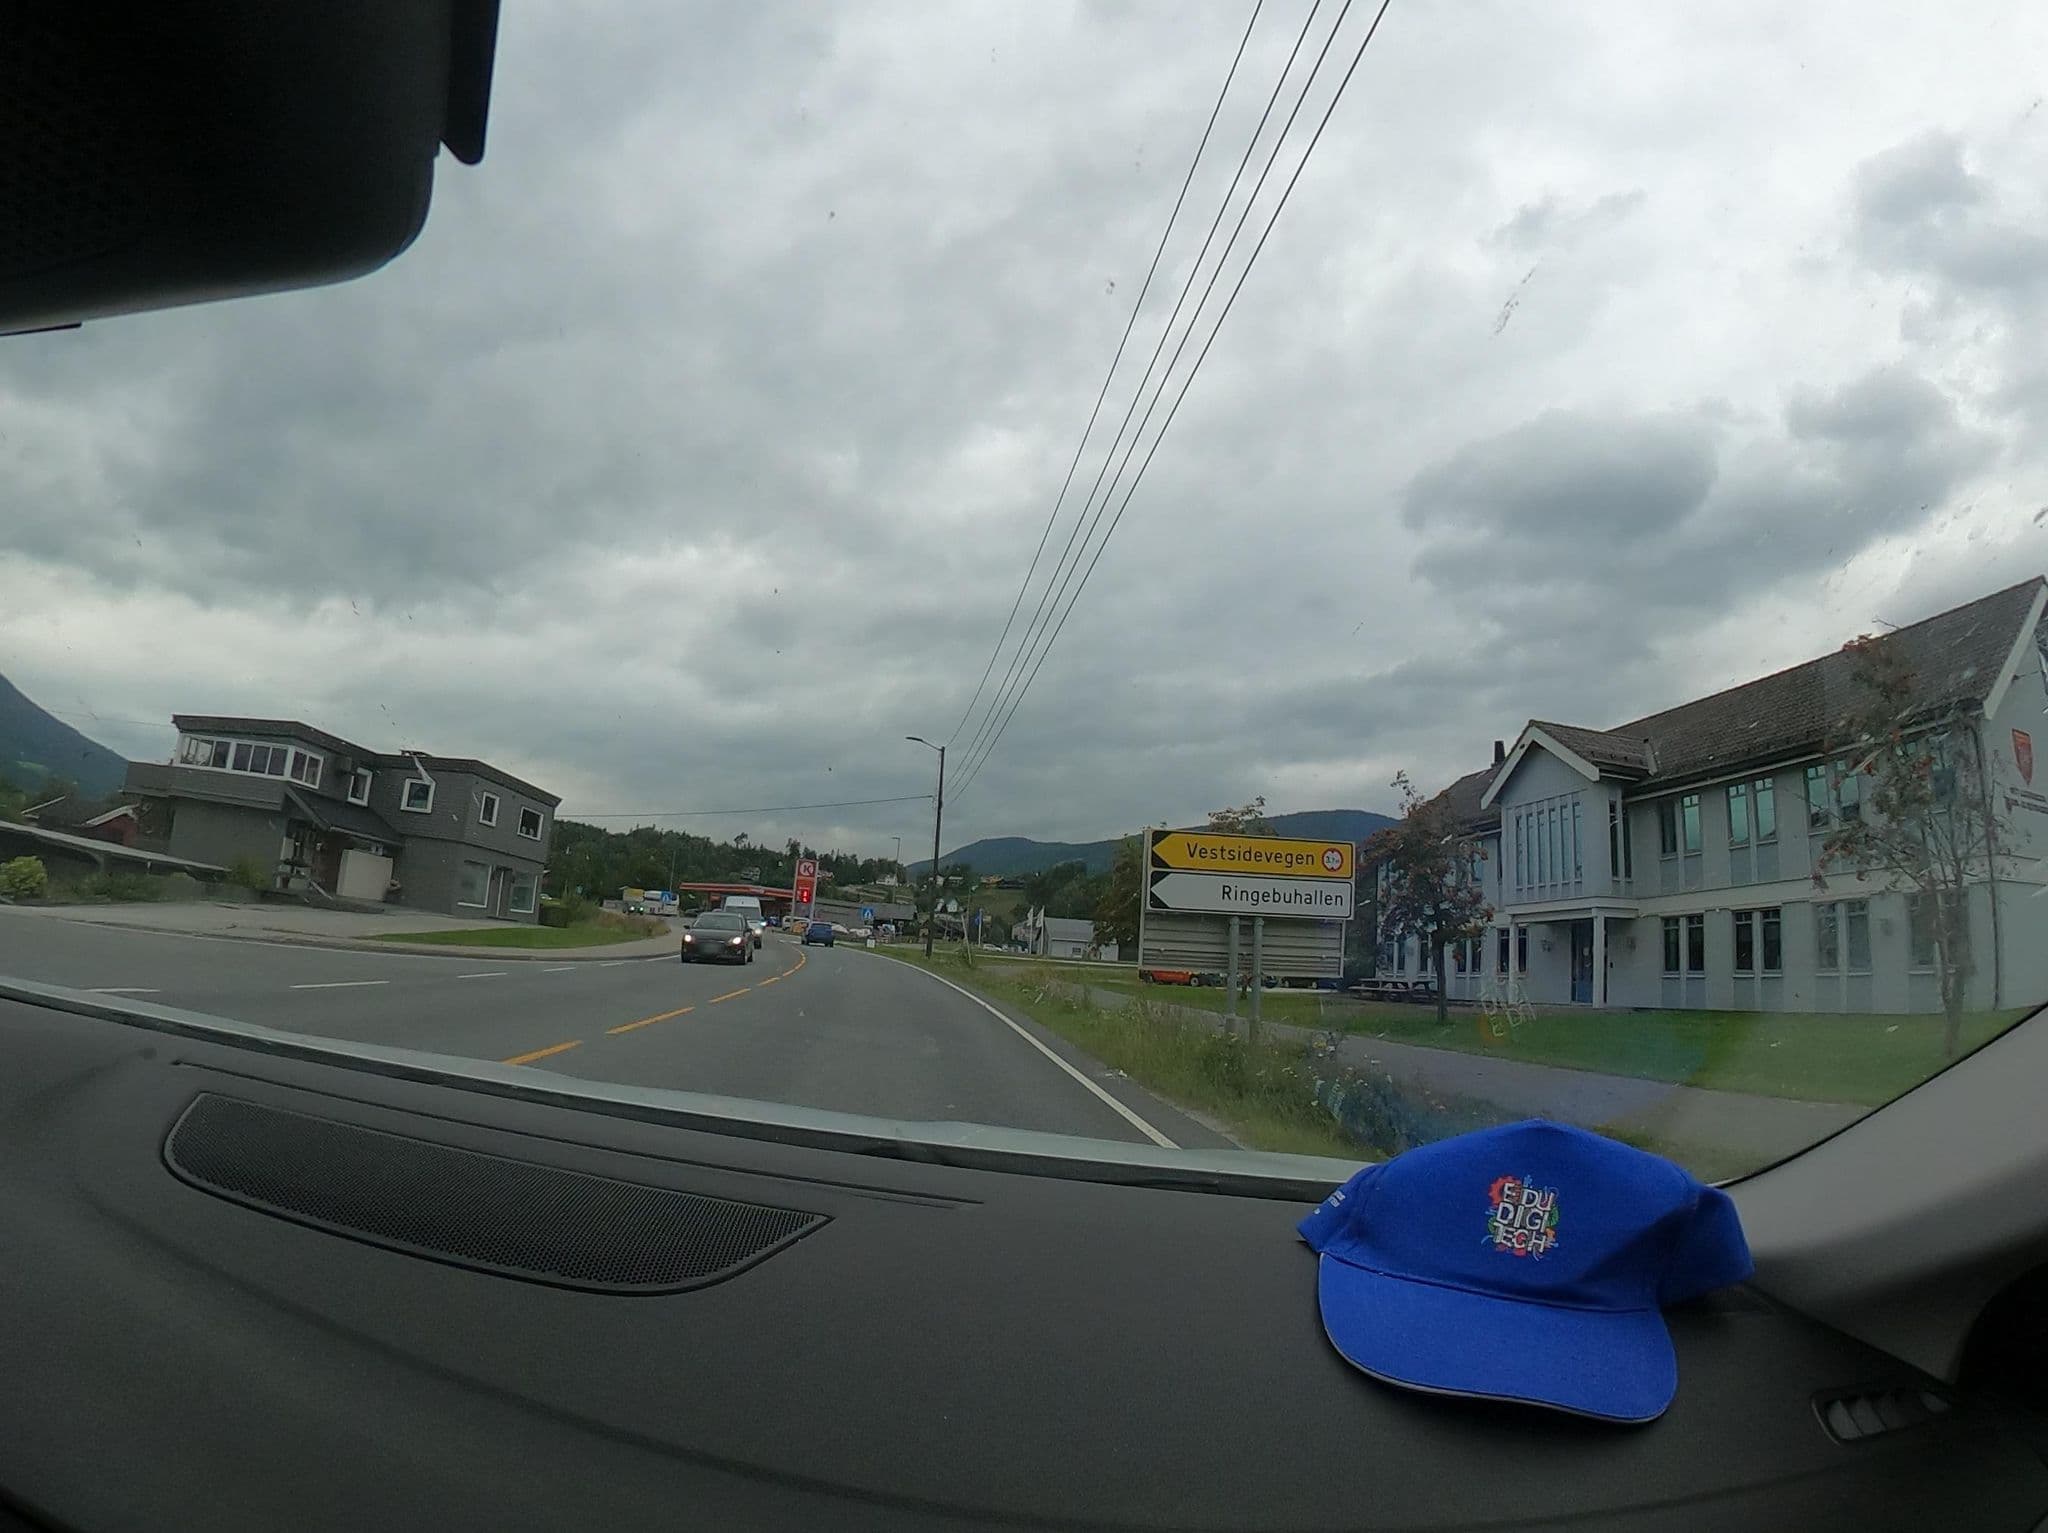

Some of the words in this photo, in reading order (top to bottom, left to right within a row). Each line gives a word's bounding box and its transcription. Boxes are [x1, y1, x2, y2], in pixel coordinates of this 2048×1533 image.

[1187, 842, 1315, 868] Vestsidevegen
[1221, 884, 1344, 907] Ringebuhallen
[1503, 1182, 1555, 1211] EDU
[1496, 1202, 1550, 1233] DIGI
[1493, 1221, 1547, 1253] TECH
